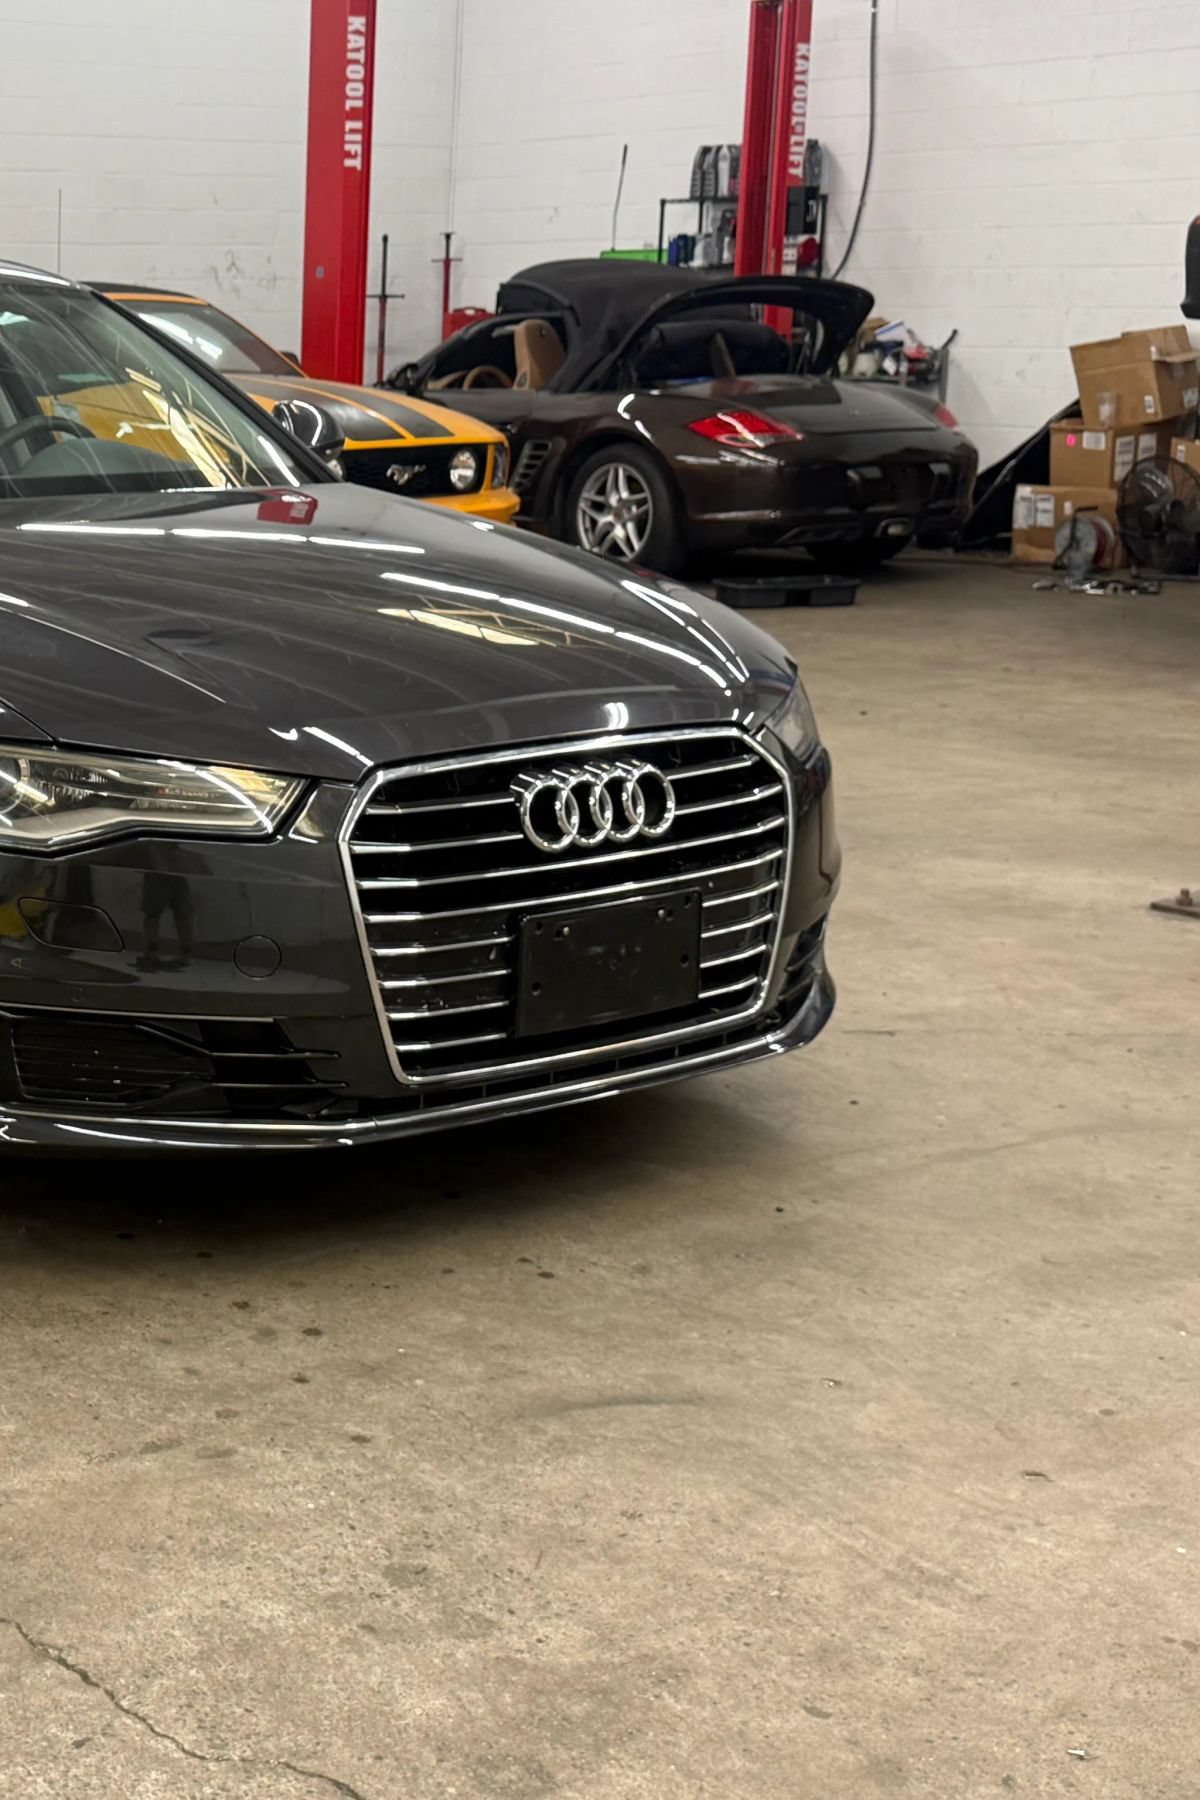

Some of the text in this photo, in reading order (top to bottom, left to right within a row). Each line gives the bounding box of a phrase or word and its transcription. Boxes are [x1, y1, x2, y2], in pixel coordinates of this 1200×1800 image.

[343, 15, 367, 171] KATOOL LIFT
[790, 42, 810, 126] KATOOL
